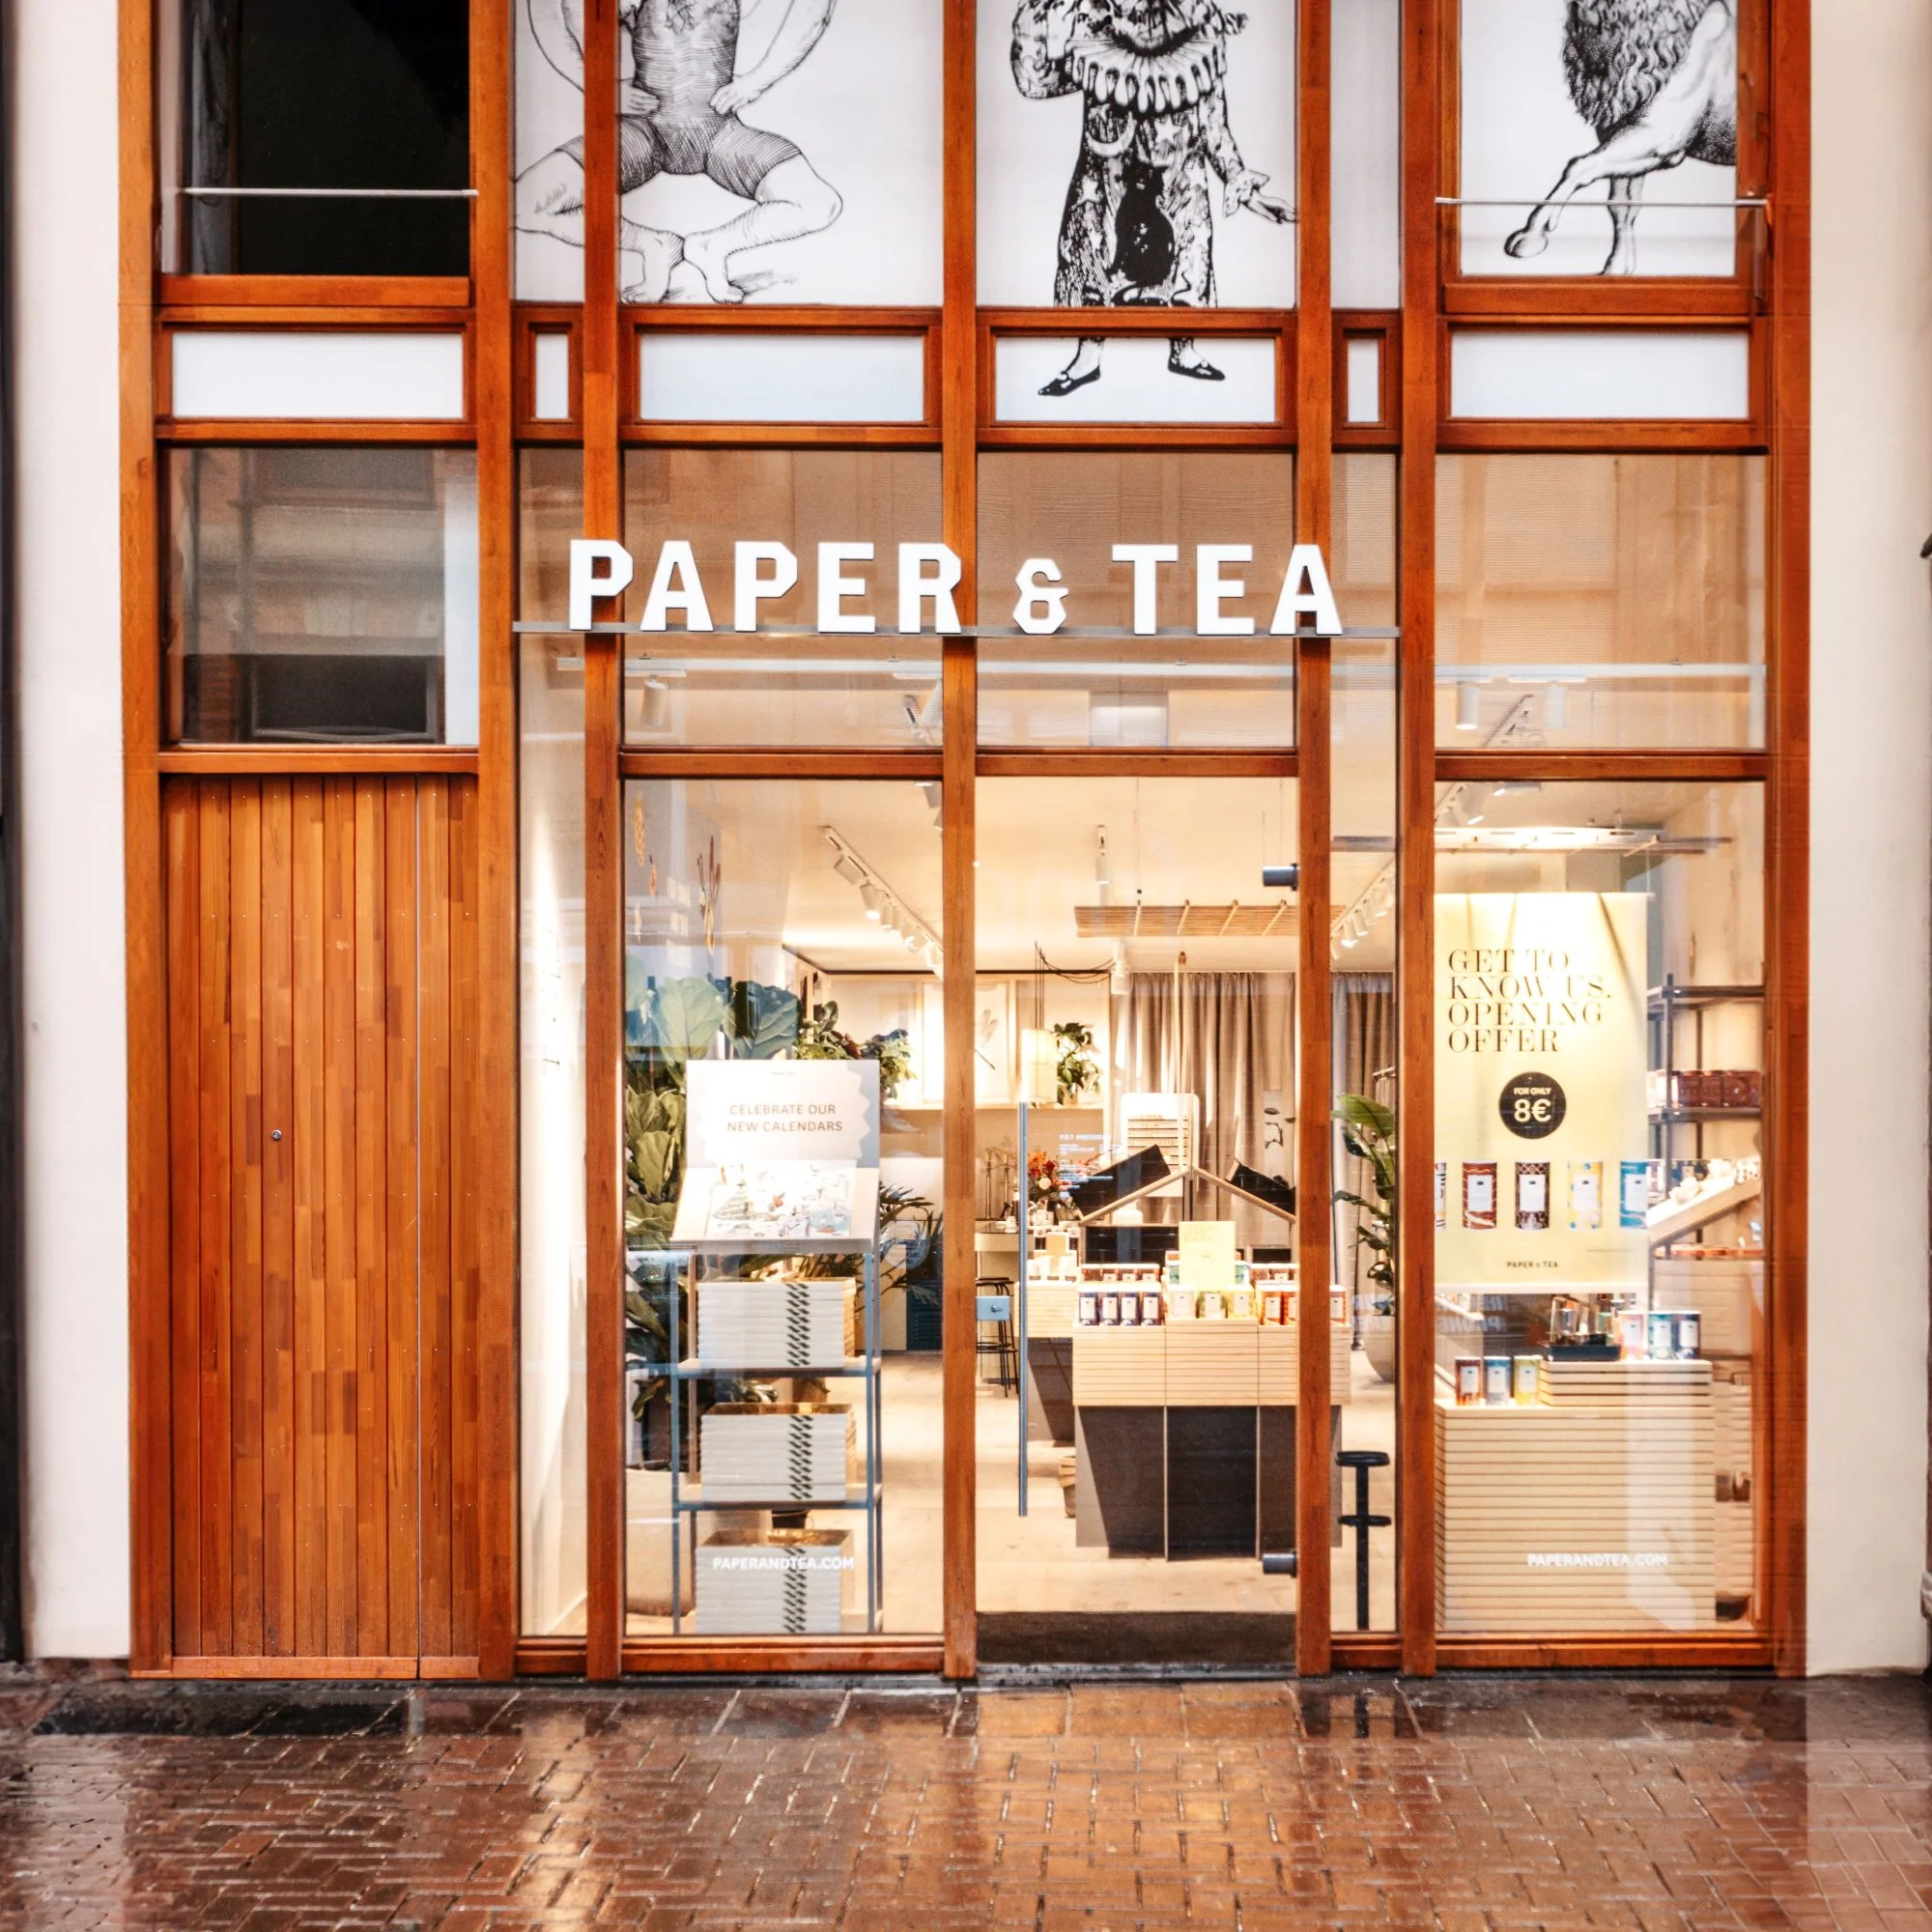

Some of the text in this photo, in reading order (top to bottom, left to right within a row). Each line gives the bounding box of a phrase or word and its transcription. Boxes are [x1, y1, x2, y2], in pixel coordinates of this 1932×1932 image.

[569, 539, 1343, 636] PAPER & TEA
[1448, 949, 1569, 973] GET TO
[1447, 976, 1550, 1000] KNOW
[1448, 1002, 1604, 1027] OPENING
[1448, 1029, 1559, 1054] OFFER
[1513, 1087, 1529, 1095] FOR
[729, 1104, 837, 1115] CELEBRATE OUR
[1514, 1098, 1551, 1122] 8€
[726, 1121, 843, 1132] NEW CALENDARS
[713, 1557, 854, 1570] PAPERANDTEA.COM
[1526, 1553, 1668, 1566] PAPERANDTEA.COM
